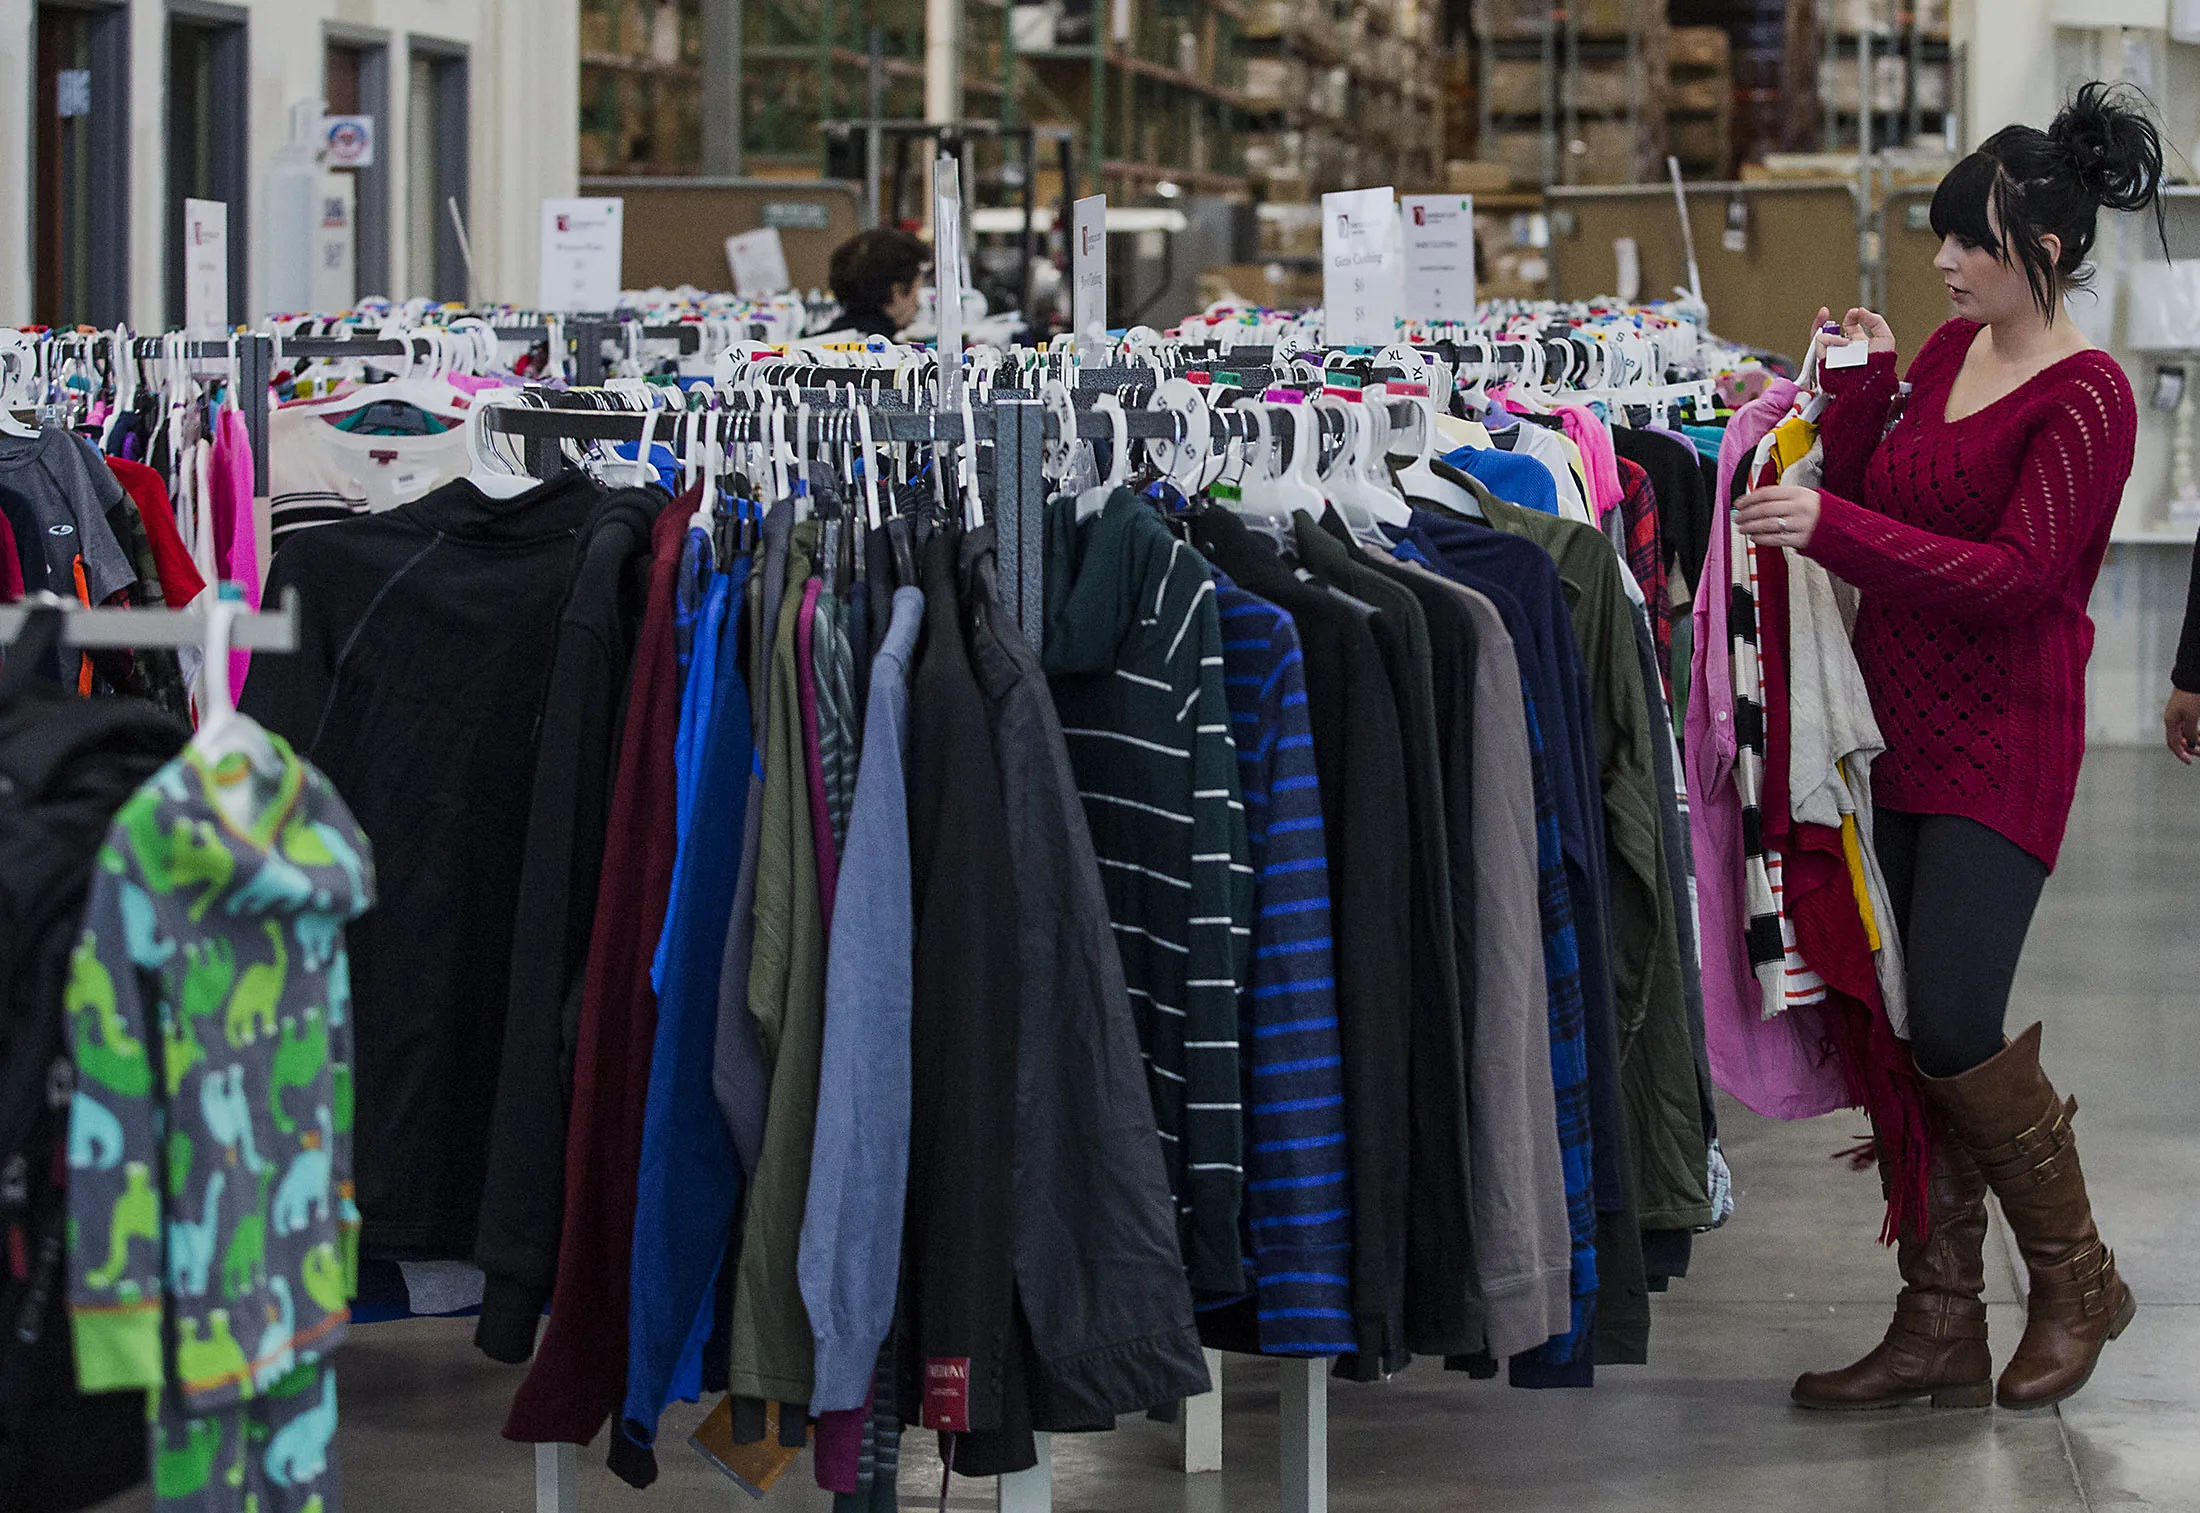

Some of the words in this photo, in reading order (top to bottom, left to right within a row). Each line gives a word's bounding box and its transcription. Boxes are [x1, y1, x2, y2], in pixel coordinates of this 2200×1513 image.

[1616, 332, 1625, 342] S
[729, 348, 744, 363] M
[1284, 340, 1298, 356] XS
[1388, 350, 1403, 360] XL
[1625, 358, 1635, 368] S
[1157, 396, 1167, 411] S
[1186, 398, 1197, 413] S
[1156, 441, 1167, 457] S
[1185, 444, 1196, 459] S
